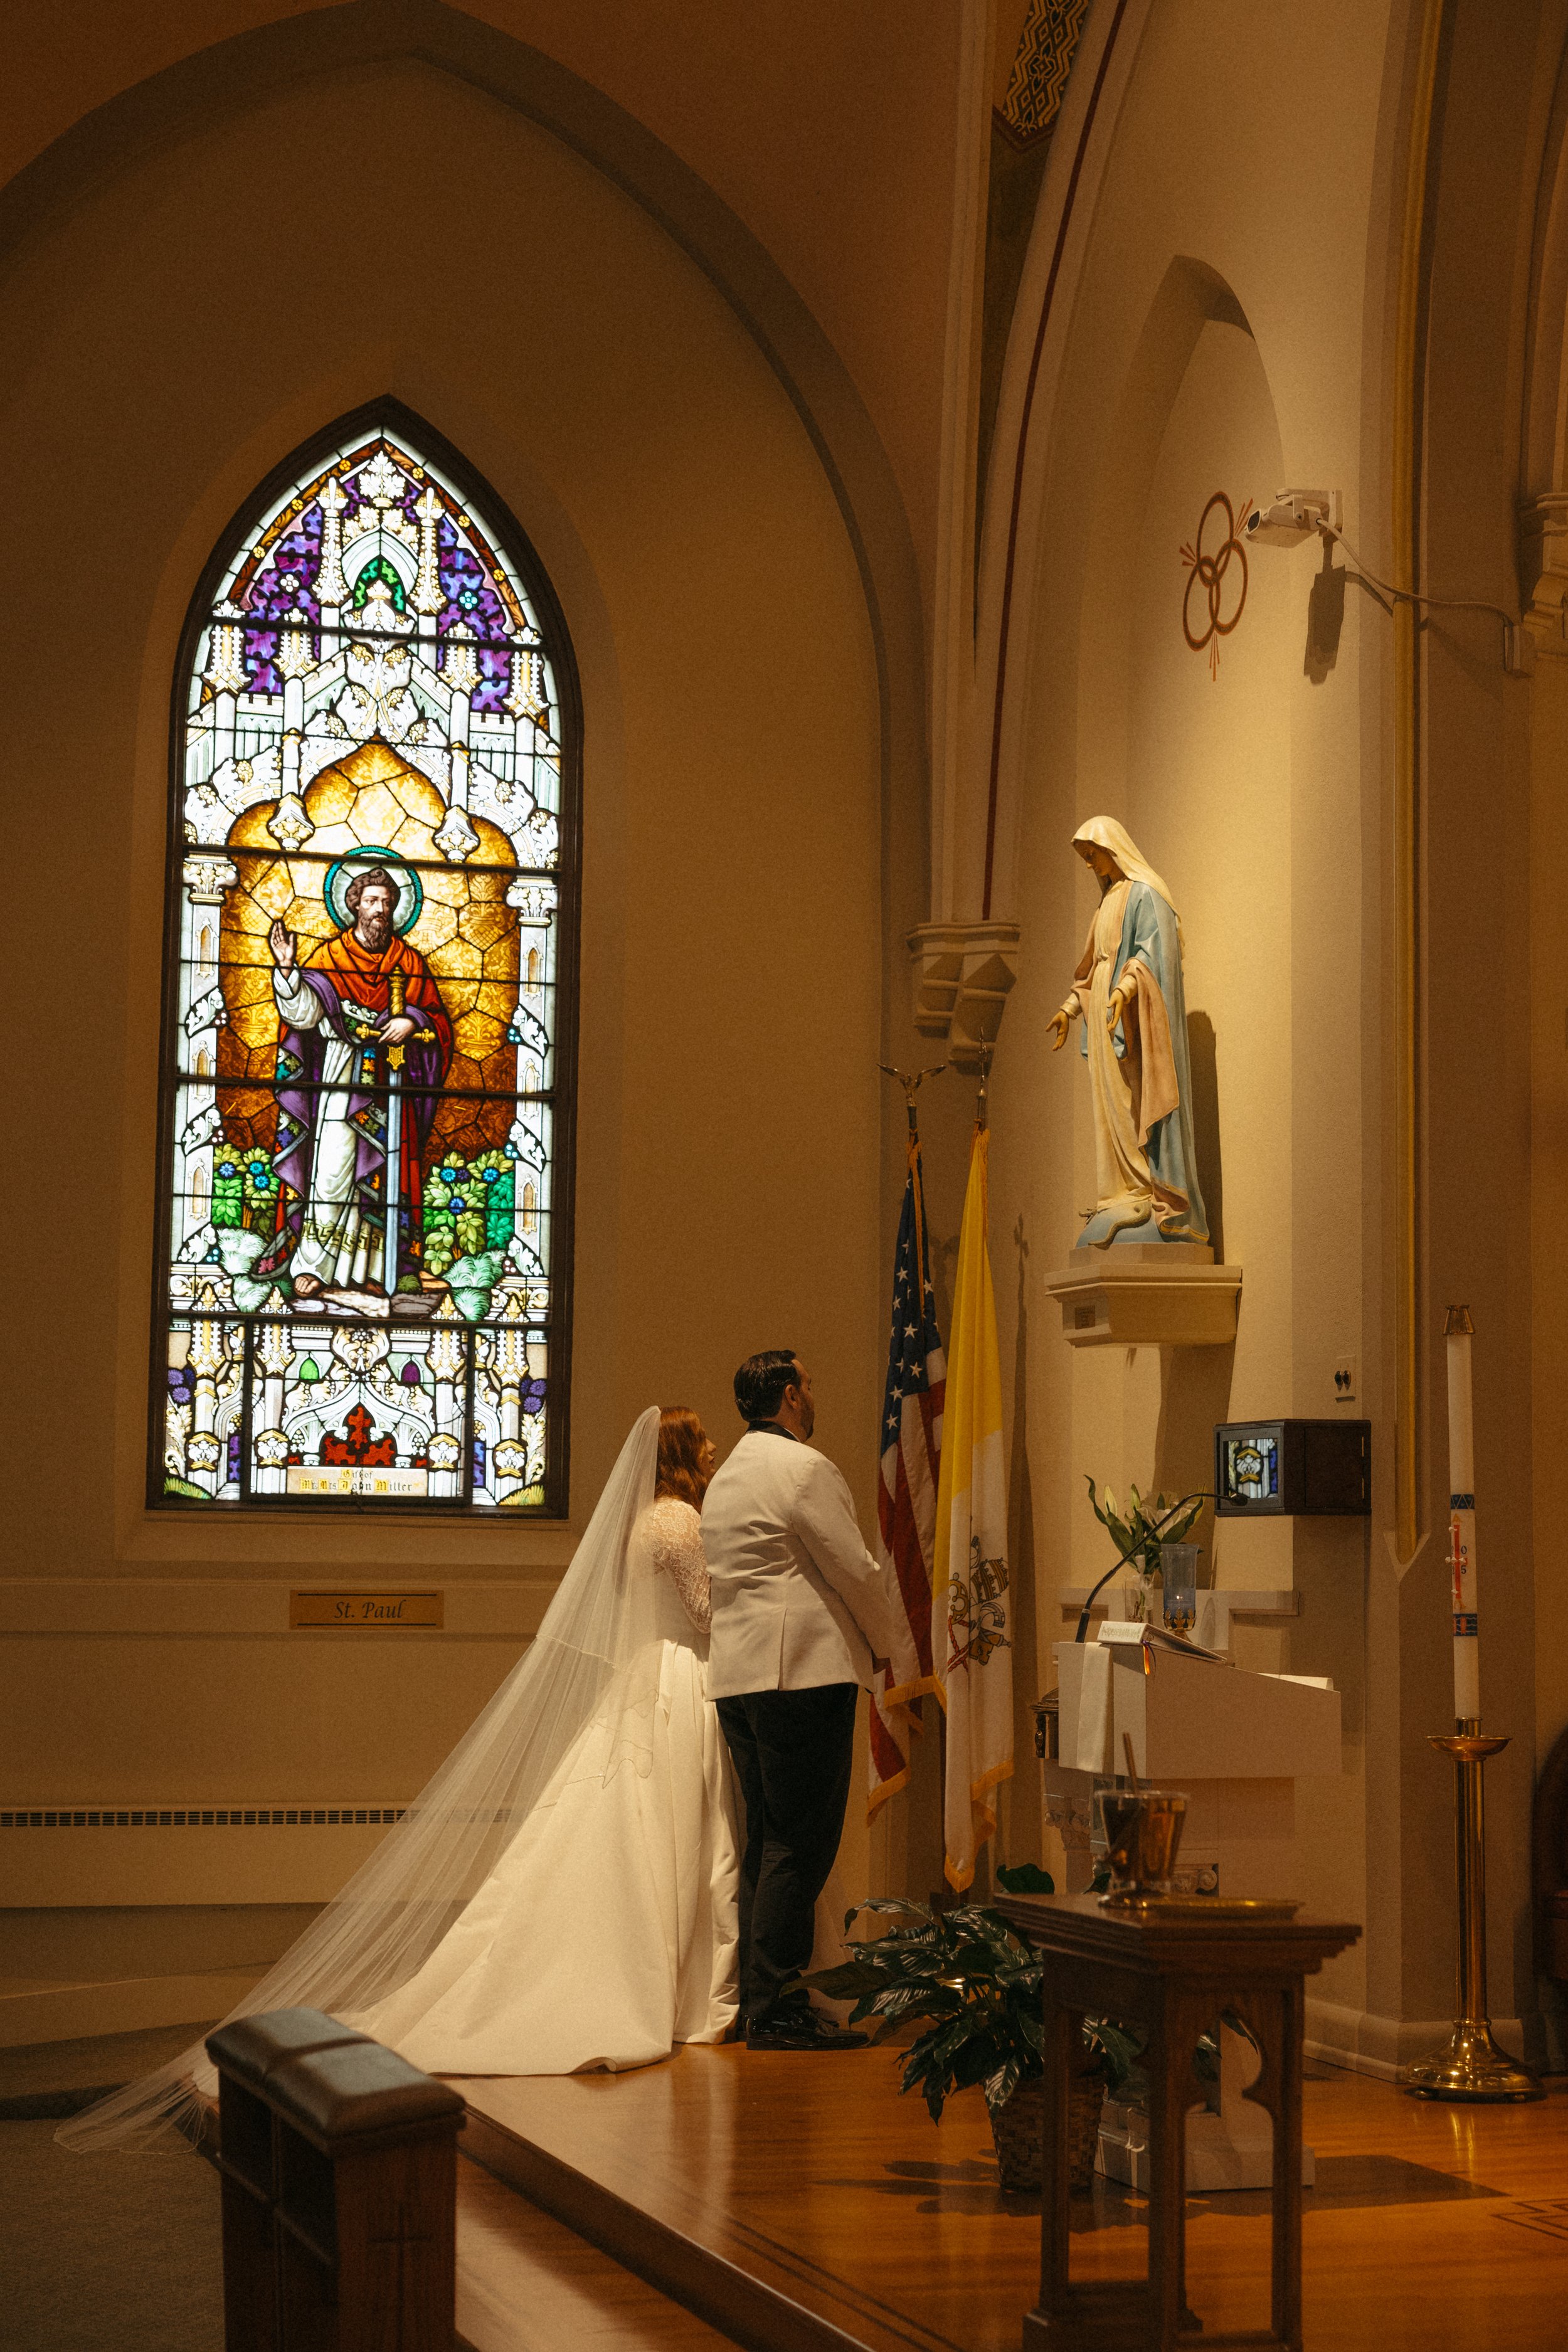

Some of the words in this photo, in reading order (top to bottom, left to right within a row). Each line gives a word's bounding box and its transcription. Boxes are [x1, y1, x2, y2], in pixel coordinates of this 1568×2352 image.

[364, 1470, 374, 1479] of
[375, 1480, 412, 1491] Miller
[1461, 1565, 1466, 1574] 5
[334, 1601, 355, 1618] St.
[362, 1599, 407, 1618] Paul
